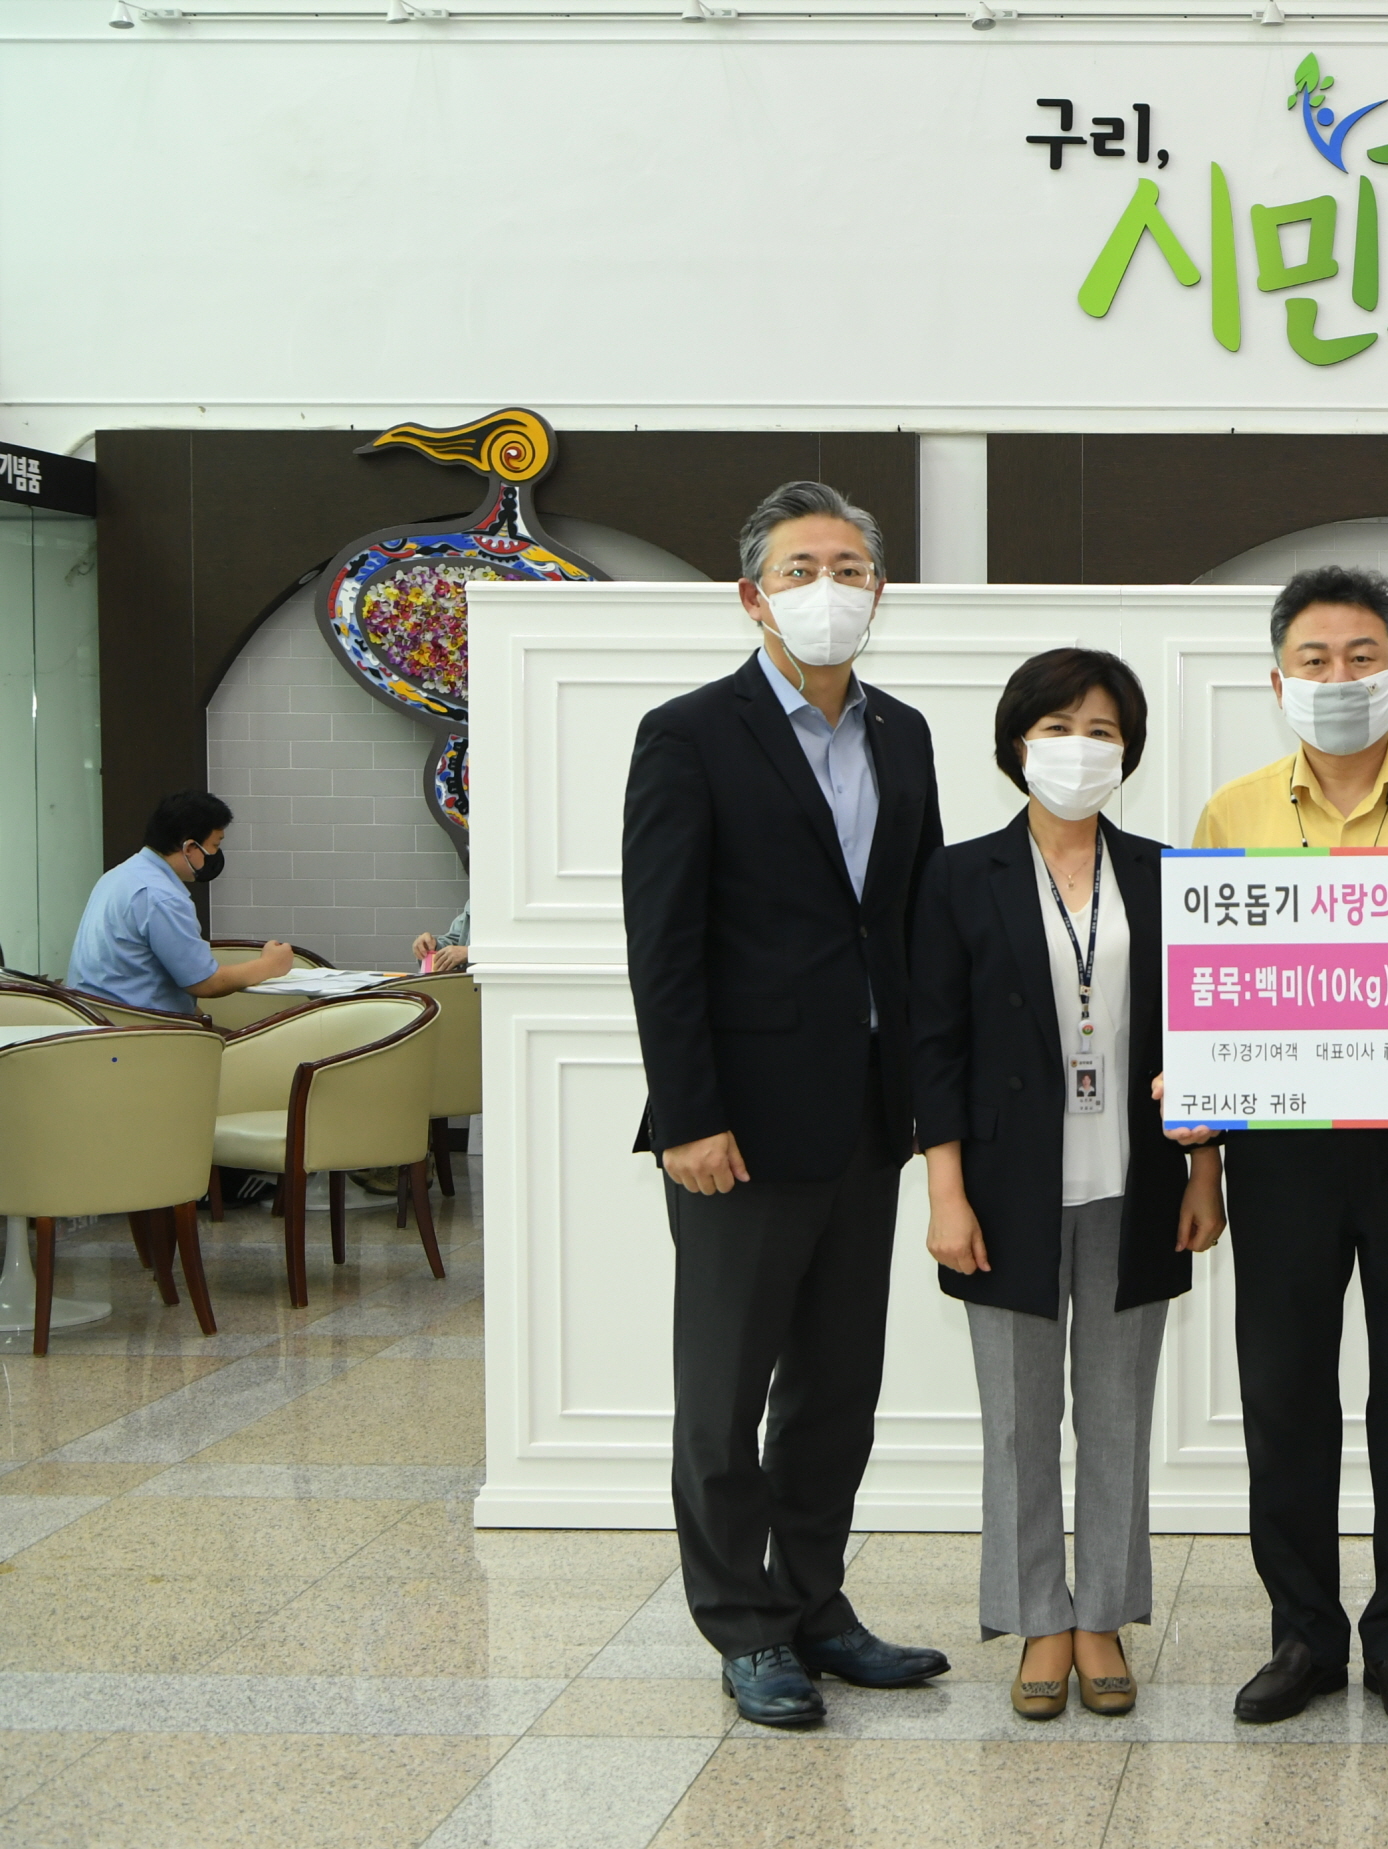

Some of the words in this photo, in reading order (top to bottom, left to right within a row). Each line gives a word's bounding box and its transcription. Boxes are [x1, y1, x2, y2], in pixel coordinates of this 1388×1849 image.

[1025, 98, 1171, 171] 구리,
[1184, 883, 1299, 927] 이웃돕기
[1211, 1042, 1299, 1062] (주)경기여객
[1315, 1041, 1375, 1061] 대표이사
[1180, 1093, 1258, 1115] 구리시장
[1270, 1092, 1307, 1115] 귀하
